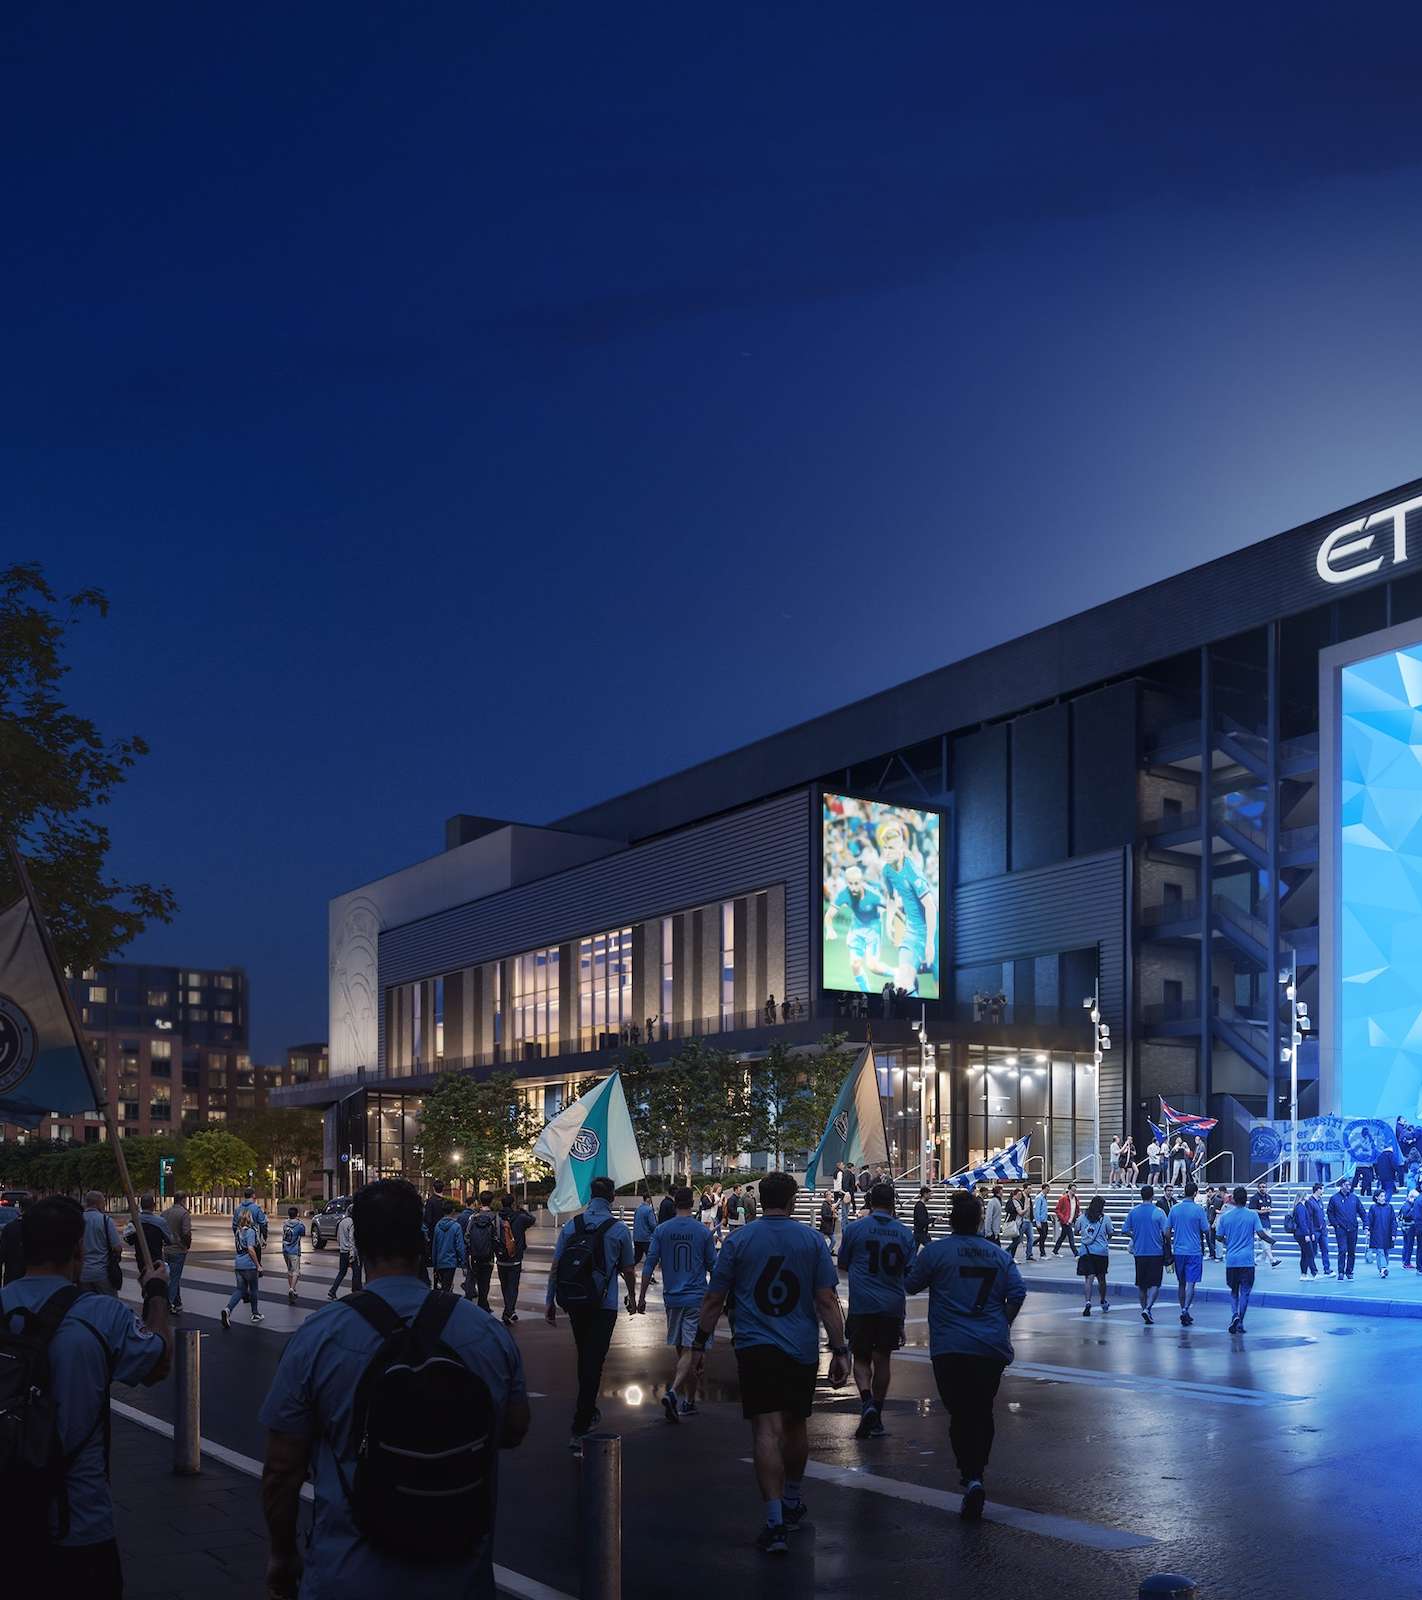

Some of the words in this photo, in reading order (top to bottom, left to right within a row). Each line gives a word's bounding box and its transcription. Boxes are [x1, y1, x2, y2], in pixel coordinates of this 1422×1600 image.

[865, 1240, 906, 1276] 10
[754, 1256, 800, 1316] 6
[959, 1266, 998, 1312] 7
